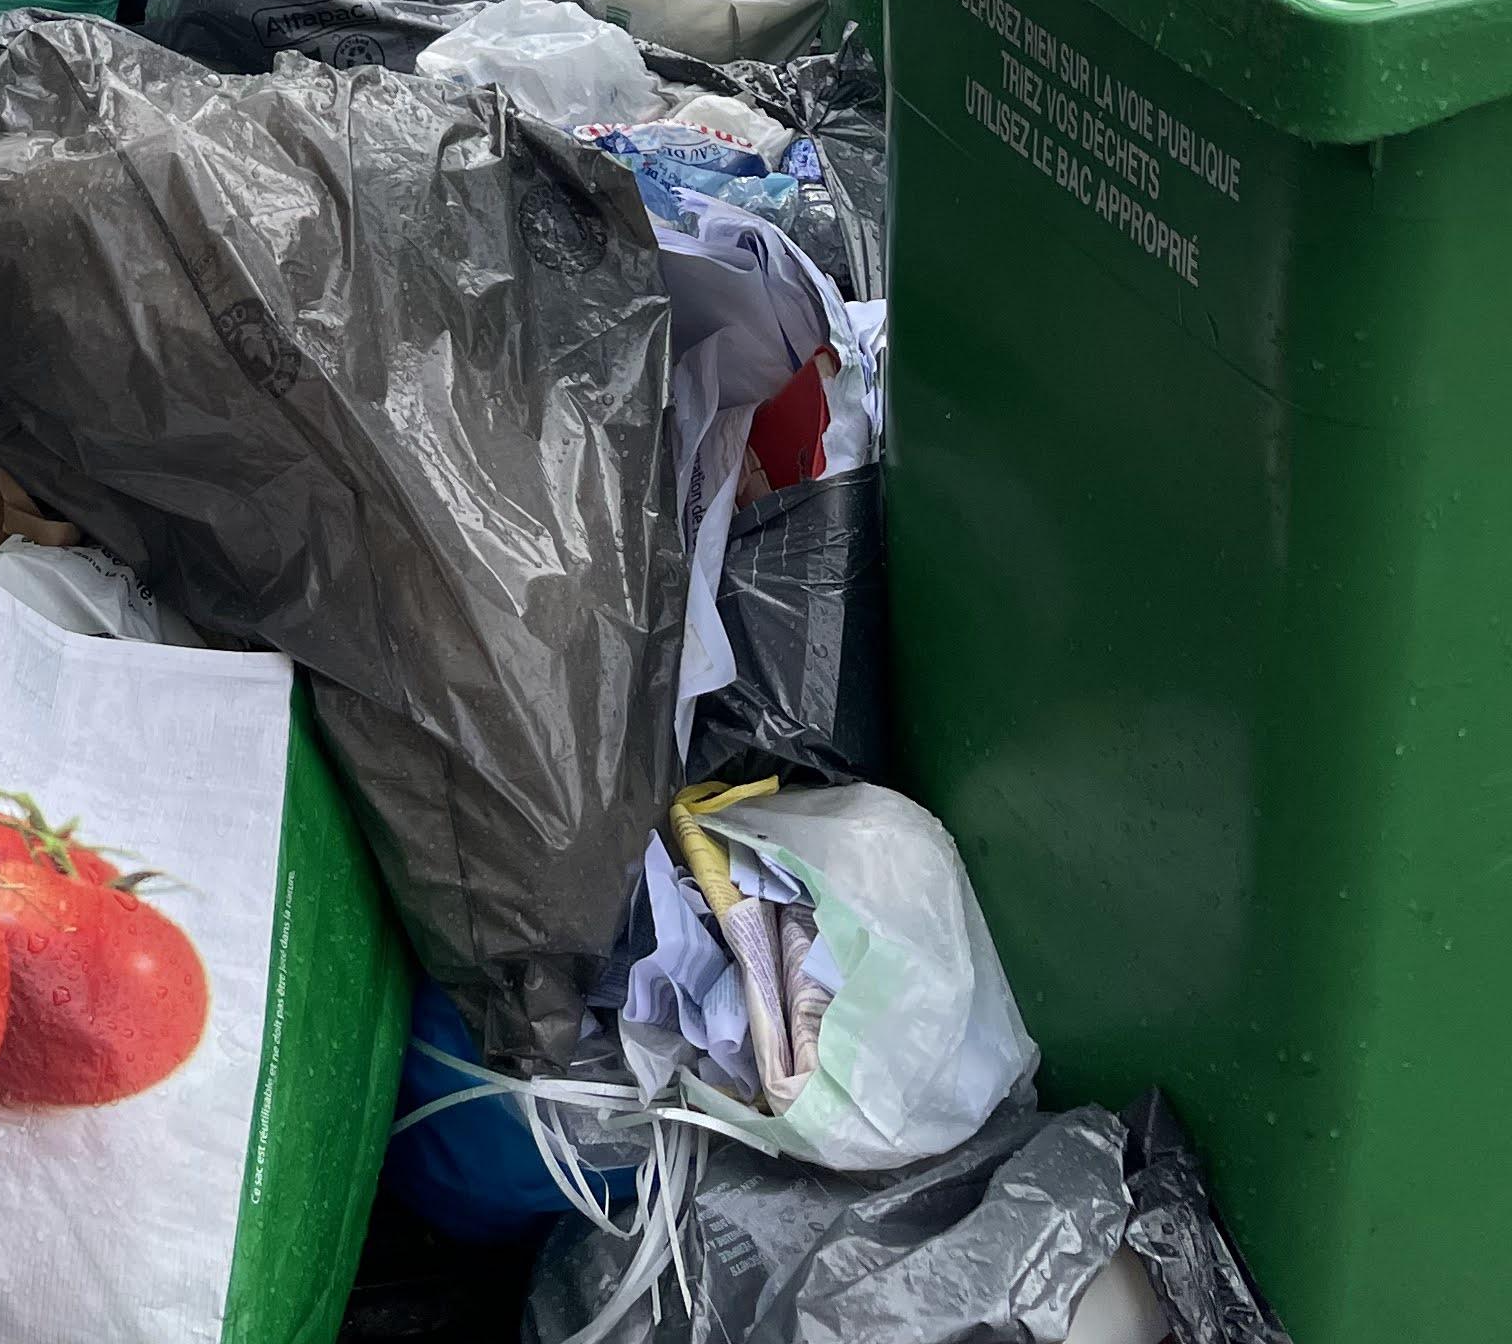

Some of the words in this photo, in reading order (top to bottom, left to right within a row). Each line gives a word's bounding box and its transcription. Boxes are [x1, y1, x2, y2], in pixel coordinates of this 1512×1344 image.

[965, 76, 1030, 159] UTILISEZ
[1033, 128, 1053, 178] LE
[1056, 146, 1092, 205] BAC
[1095, 178, 1200, 288] APPROPRIÉ
[1001, 50, 1043, 115] TRIEZ
[1046, 93, 1078, 140] VOS
[1082, 110, 1160, 200] DÉCHETS
[1024, 17, 1057, 73] RIEN
[1060, 43, 1090, 97] SUR
[1094, 66, 1113, 114] LA
[1117, 80, 1153, 142] VOIE
[1157, 109, 1241, 202] PUBLIQUE
